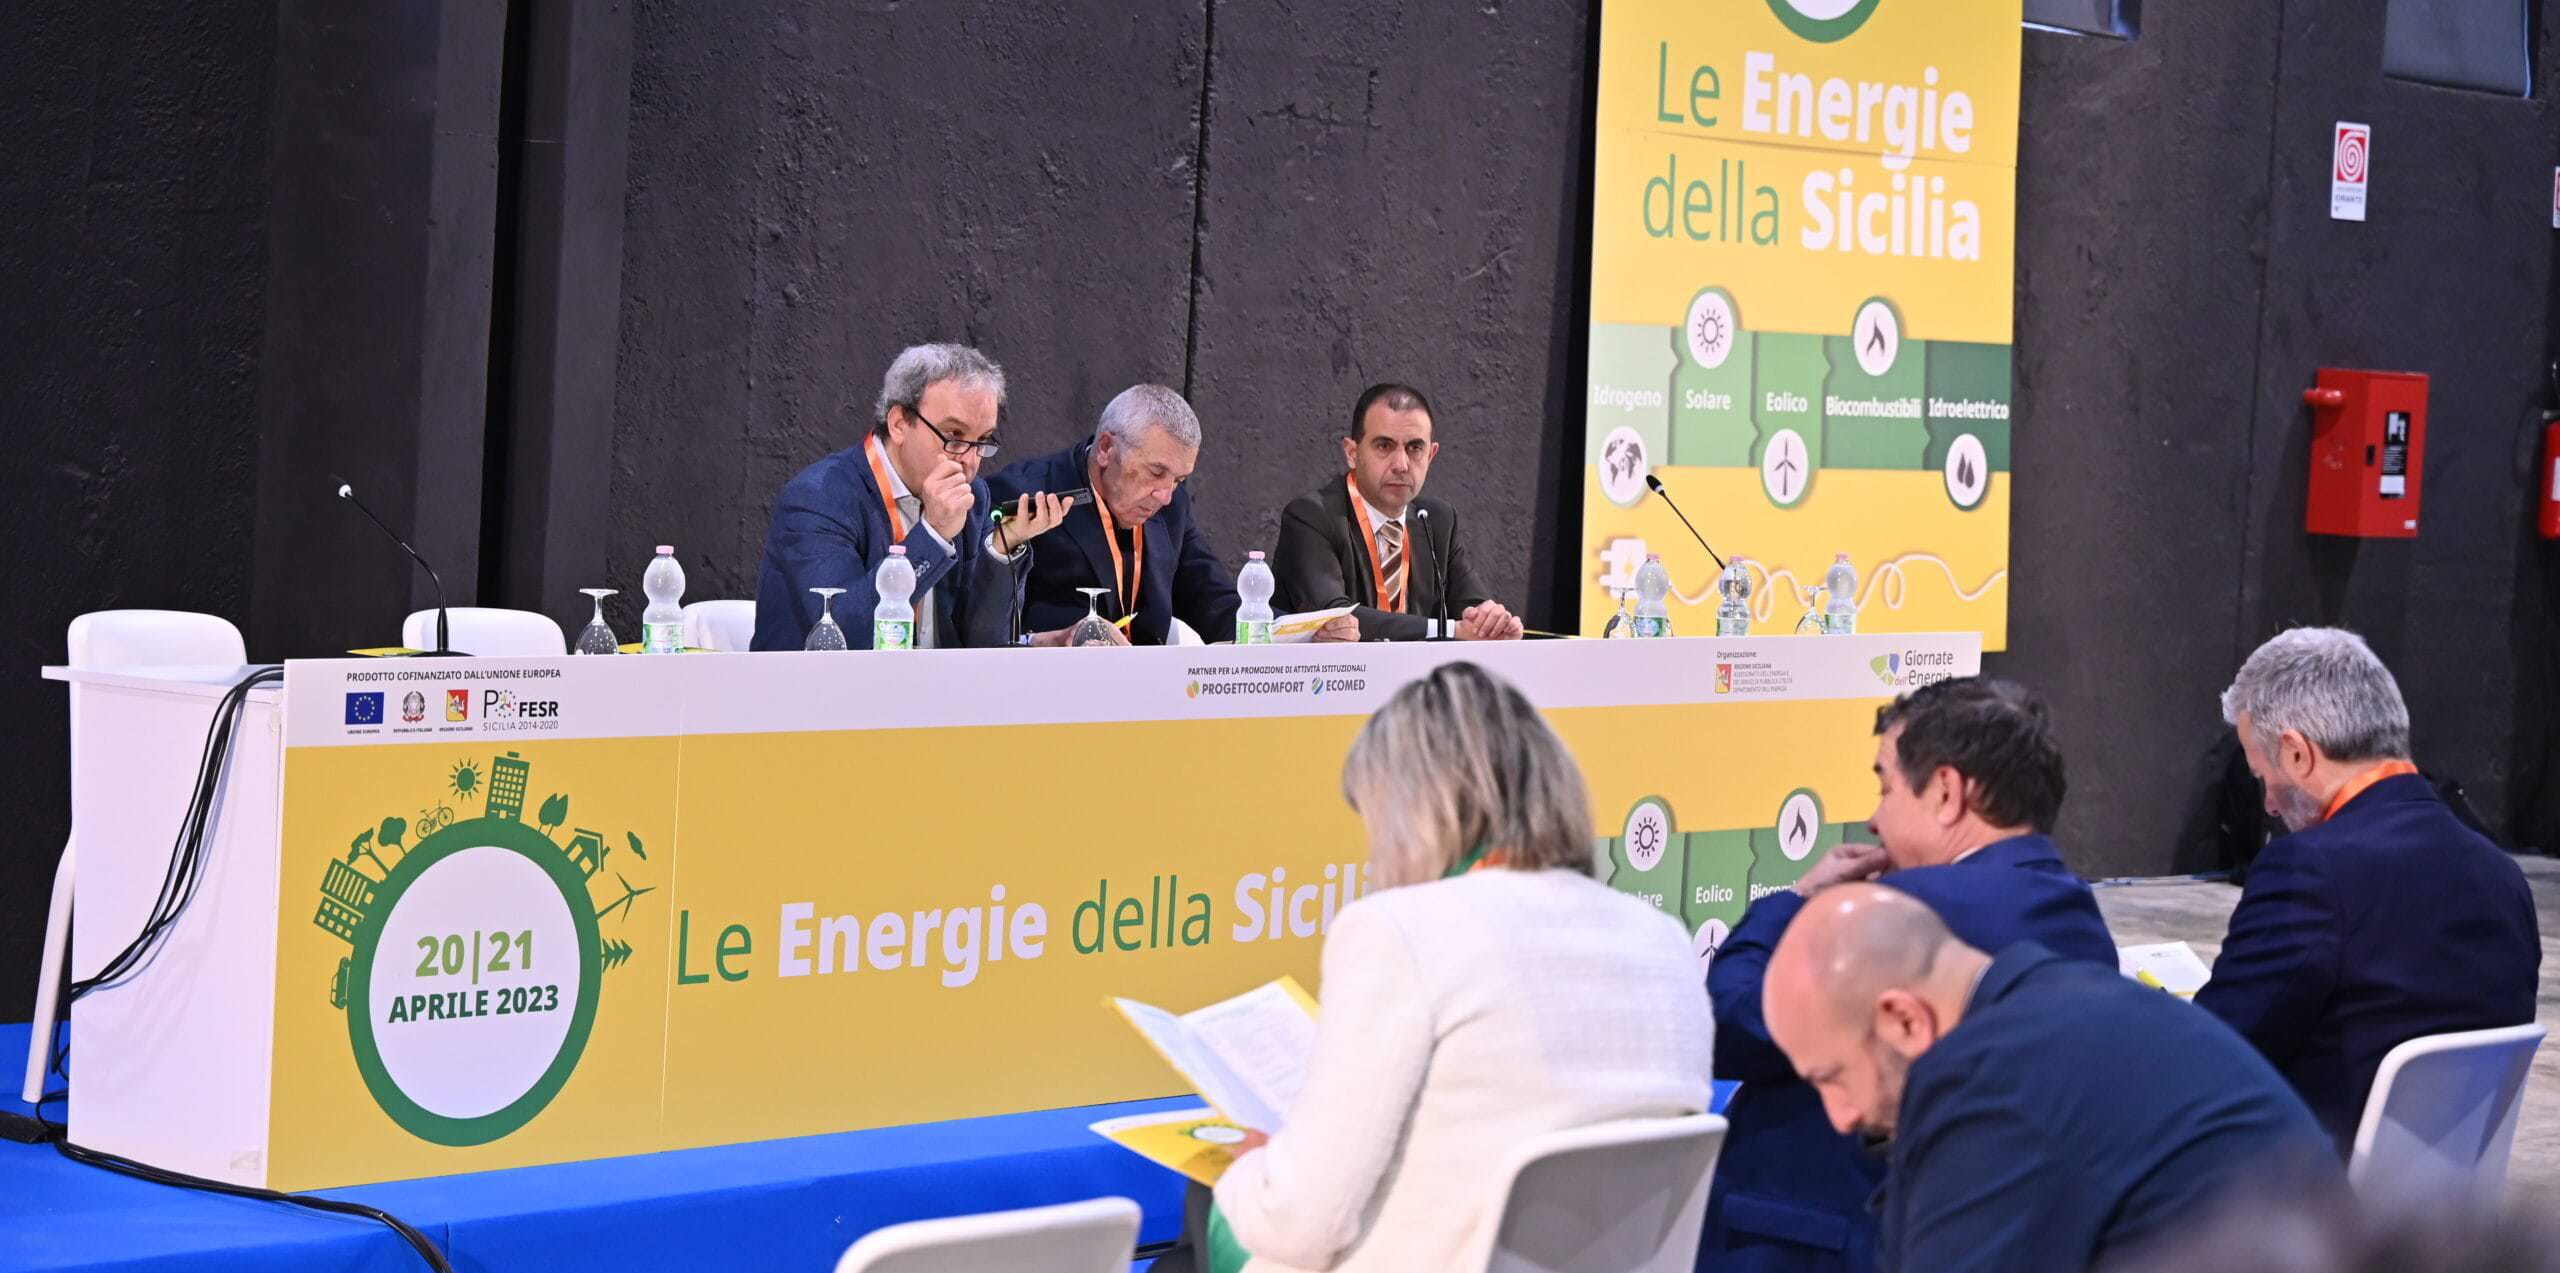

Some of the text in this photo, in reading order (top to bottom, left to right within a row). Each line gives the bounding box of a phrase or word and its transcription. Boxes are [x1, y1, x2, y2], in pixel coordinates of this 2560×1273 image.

[1657, 41, 1974, 171] Le Energie
[1643, 153, 1981, 262] della Sicilia
[1592, 385, 1663, 412] Idrogeno
[1685, 388, 1732, 411] Solare
[1766, 391, 1808, 413] Eolico
[1825, 396, 1922, 419] Biocombustibili
[1928, 398, 2010, 420] Idroelettrico
[1905, 650, 1954, 666] Giornate
[346, 669, 561, 682] PRODOTTO COFINANZIATO DALL'UNIONE EUROPEA
[1187, 664, 1367, 676] PARTNER PER LA PROMOZIONE DI ATTIVITÀ ISTITUZIONALI
[1202, 681, 1304, 695] PROGETTOCOMFORT
[1326, 679, 1366, 692] ECOMED
[519, 701, 559, 718] FESR
[483, 720, 560, 732] SICILIA 2014-2020
[1695, 884, 1733, 904] Eolico
[677, 862, 1375, 988] Le Energie della Sicili
[388, 984, 559, 1023] APRILE 2023
